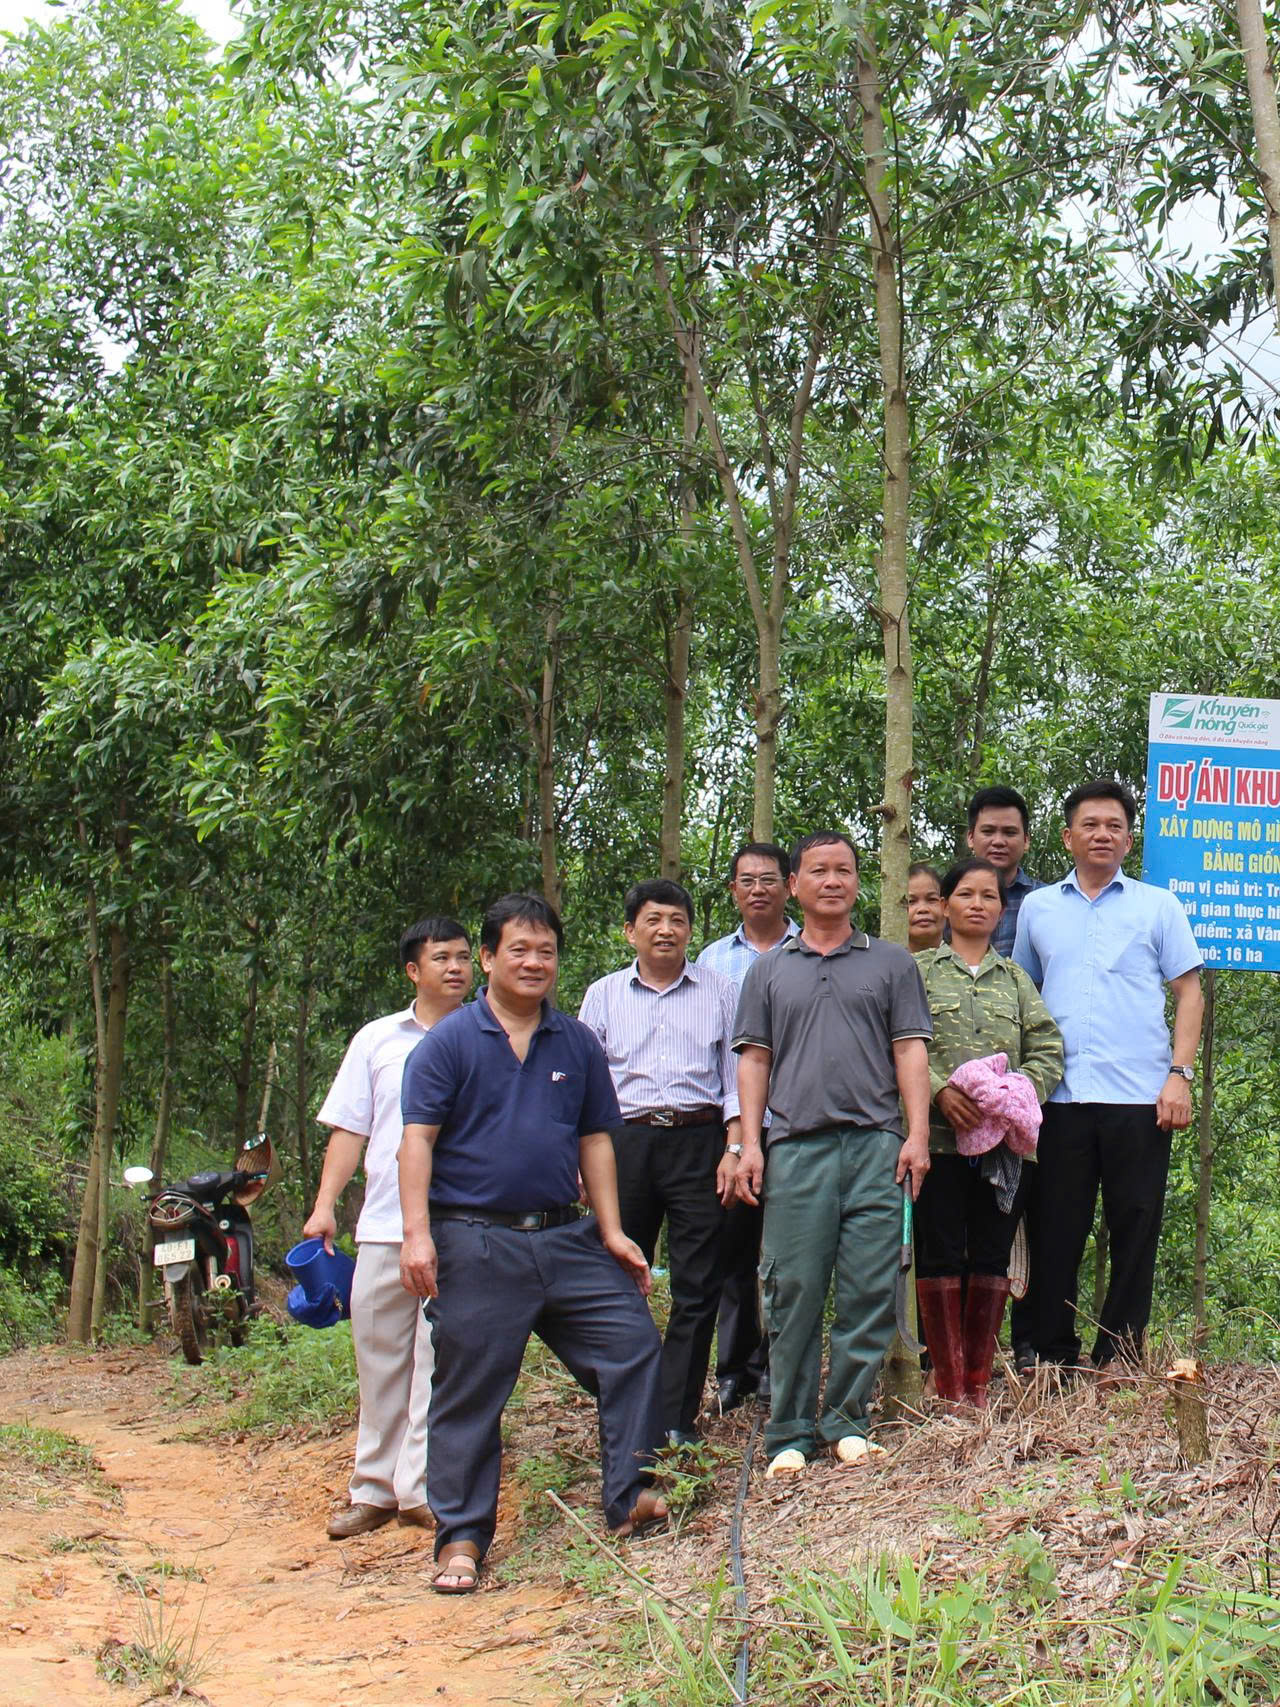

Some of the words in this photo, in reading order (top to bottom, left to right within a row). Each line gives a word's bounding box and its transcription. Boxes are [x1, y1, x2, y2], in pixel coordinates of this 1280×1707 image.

[1194, 717, 1237, 736] nông
[1158, 761, 1195, 811] DỰ
[1194, 758, 1230, 805] ÁN
[1159, 814, 1188, 838] XÂY
[1192, 818, 1233, 844] DỰNG
[1238, 818, 1262, 842] MÔ
[1203, 843, 1244, 873] BẰNG
[1168, 878, 1195, 893] Đơn
[1198, 880, 1211, 897] vị
[1215, 880, 1240, 896] chủ
[1244, 882, 1263, 897] trì:
[1201, 902, 1230, 917] gian
[1234, 903, 1264, 921] thực
[1194, 921, 1232, 939] điểm:
[1236, 924, 1253, 940] xã
[1256, 926, 1280, 941] Vân
[1225, 947, 1242, 961] 16
[1245, 948, 1263, 963] ha
